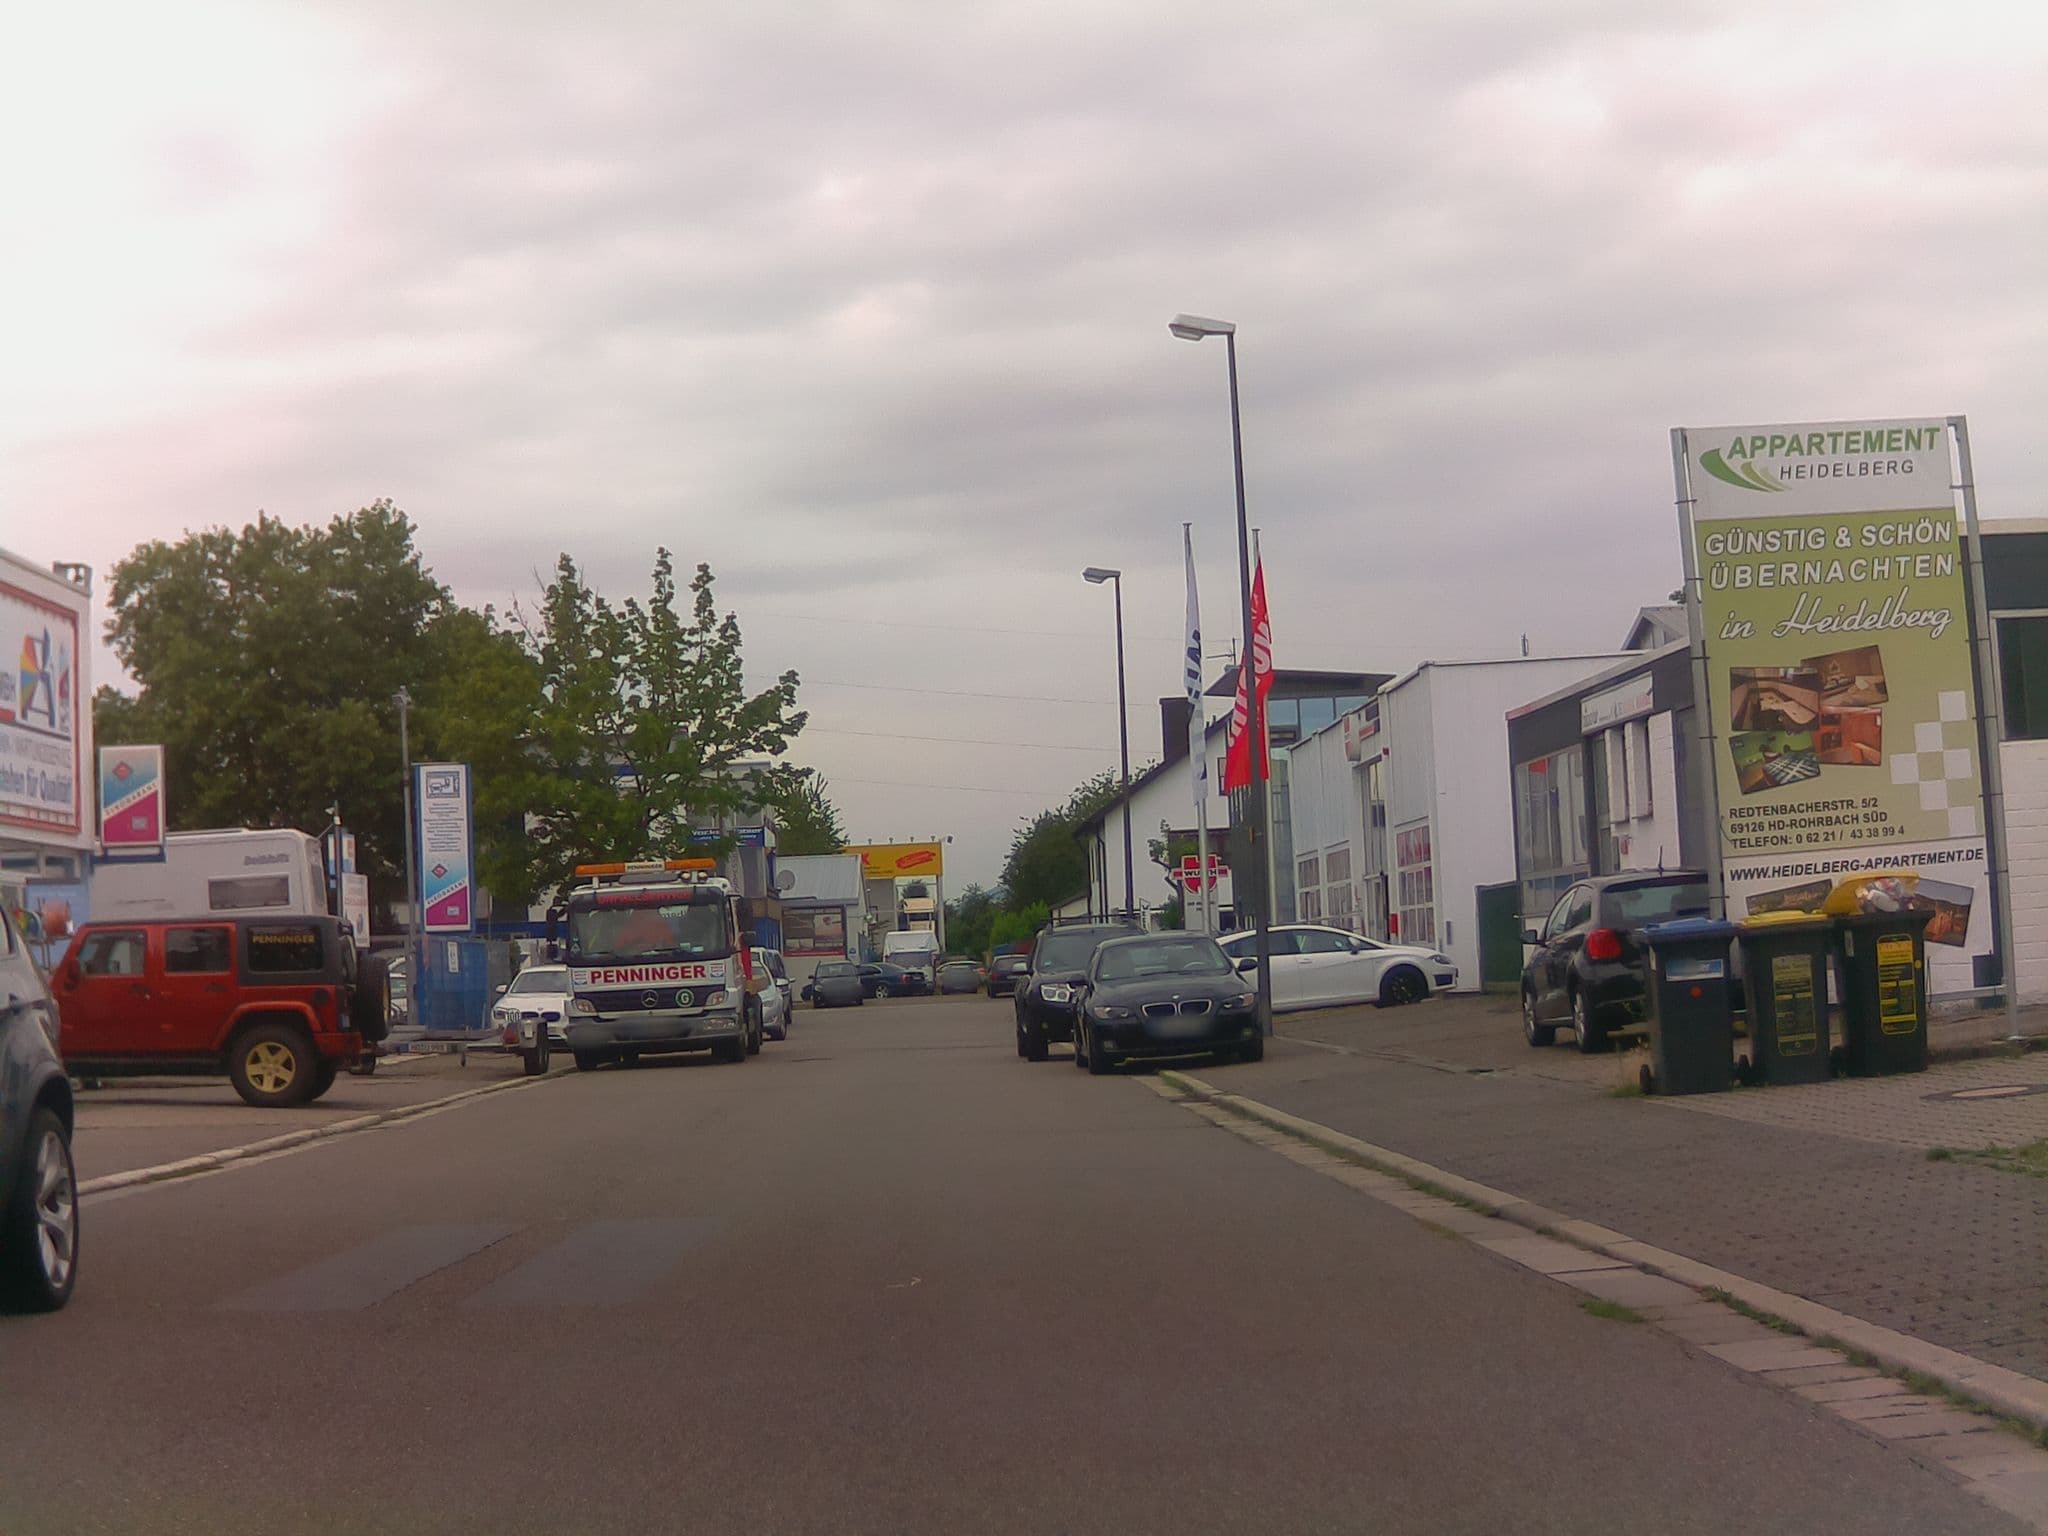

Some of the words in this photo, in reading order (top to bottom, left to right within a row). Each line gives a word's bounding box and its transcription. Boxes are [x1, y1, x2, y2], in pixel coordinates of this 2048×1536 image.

[1727, 427, 1940, 460] APPARTEMENT
[1780, 459, 1914, 480] HEIDELBERG
[1705, 528, 1826, 555] GÜNSTIG
[1835, 526, 1852, 549] &
[1861, 518, 1952, 547] SCHÖN
[1710, 554, 1953, 590] ÜBERNACHTEN
[1719, 611, 1756, 640] in
[1772, 585, 1953, 639] Heidelberg
[1729, 799, 1857, 819] REDTENBACHERSTR.
[1861, 797, 1878, 808] 5/2
[1730, 821, 1764, 834] 69126
[1768, 814, 1859, 831] HD-ROHRBACH
[1863, 811, 1888, 823] SÜD
[1732, 836, 1792, 849] TELEFON:
[1796, 834, 1803, 844] 0
[1806, 832, 1820, 843] 62
[1823, 831, 1835, 842] 21
[1850, 829, 1863, 839] 43
[1730, 848, 1984, 881] WWW.HEIDELBERG-APPARTEMENT.DE
[252, 934, 315, 943] PENNINGER
[590, 965, 706, 984] PENNINGER
[680, 992, 689, 1004] G
